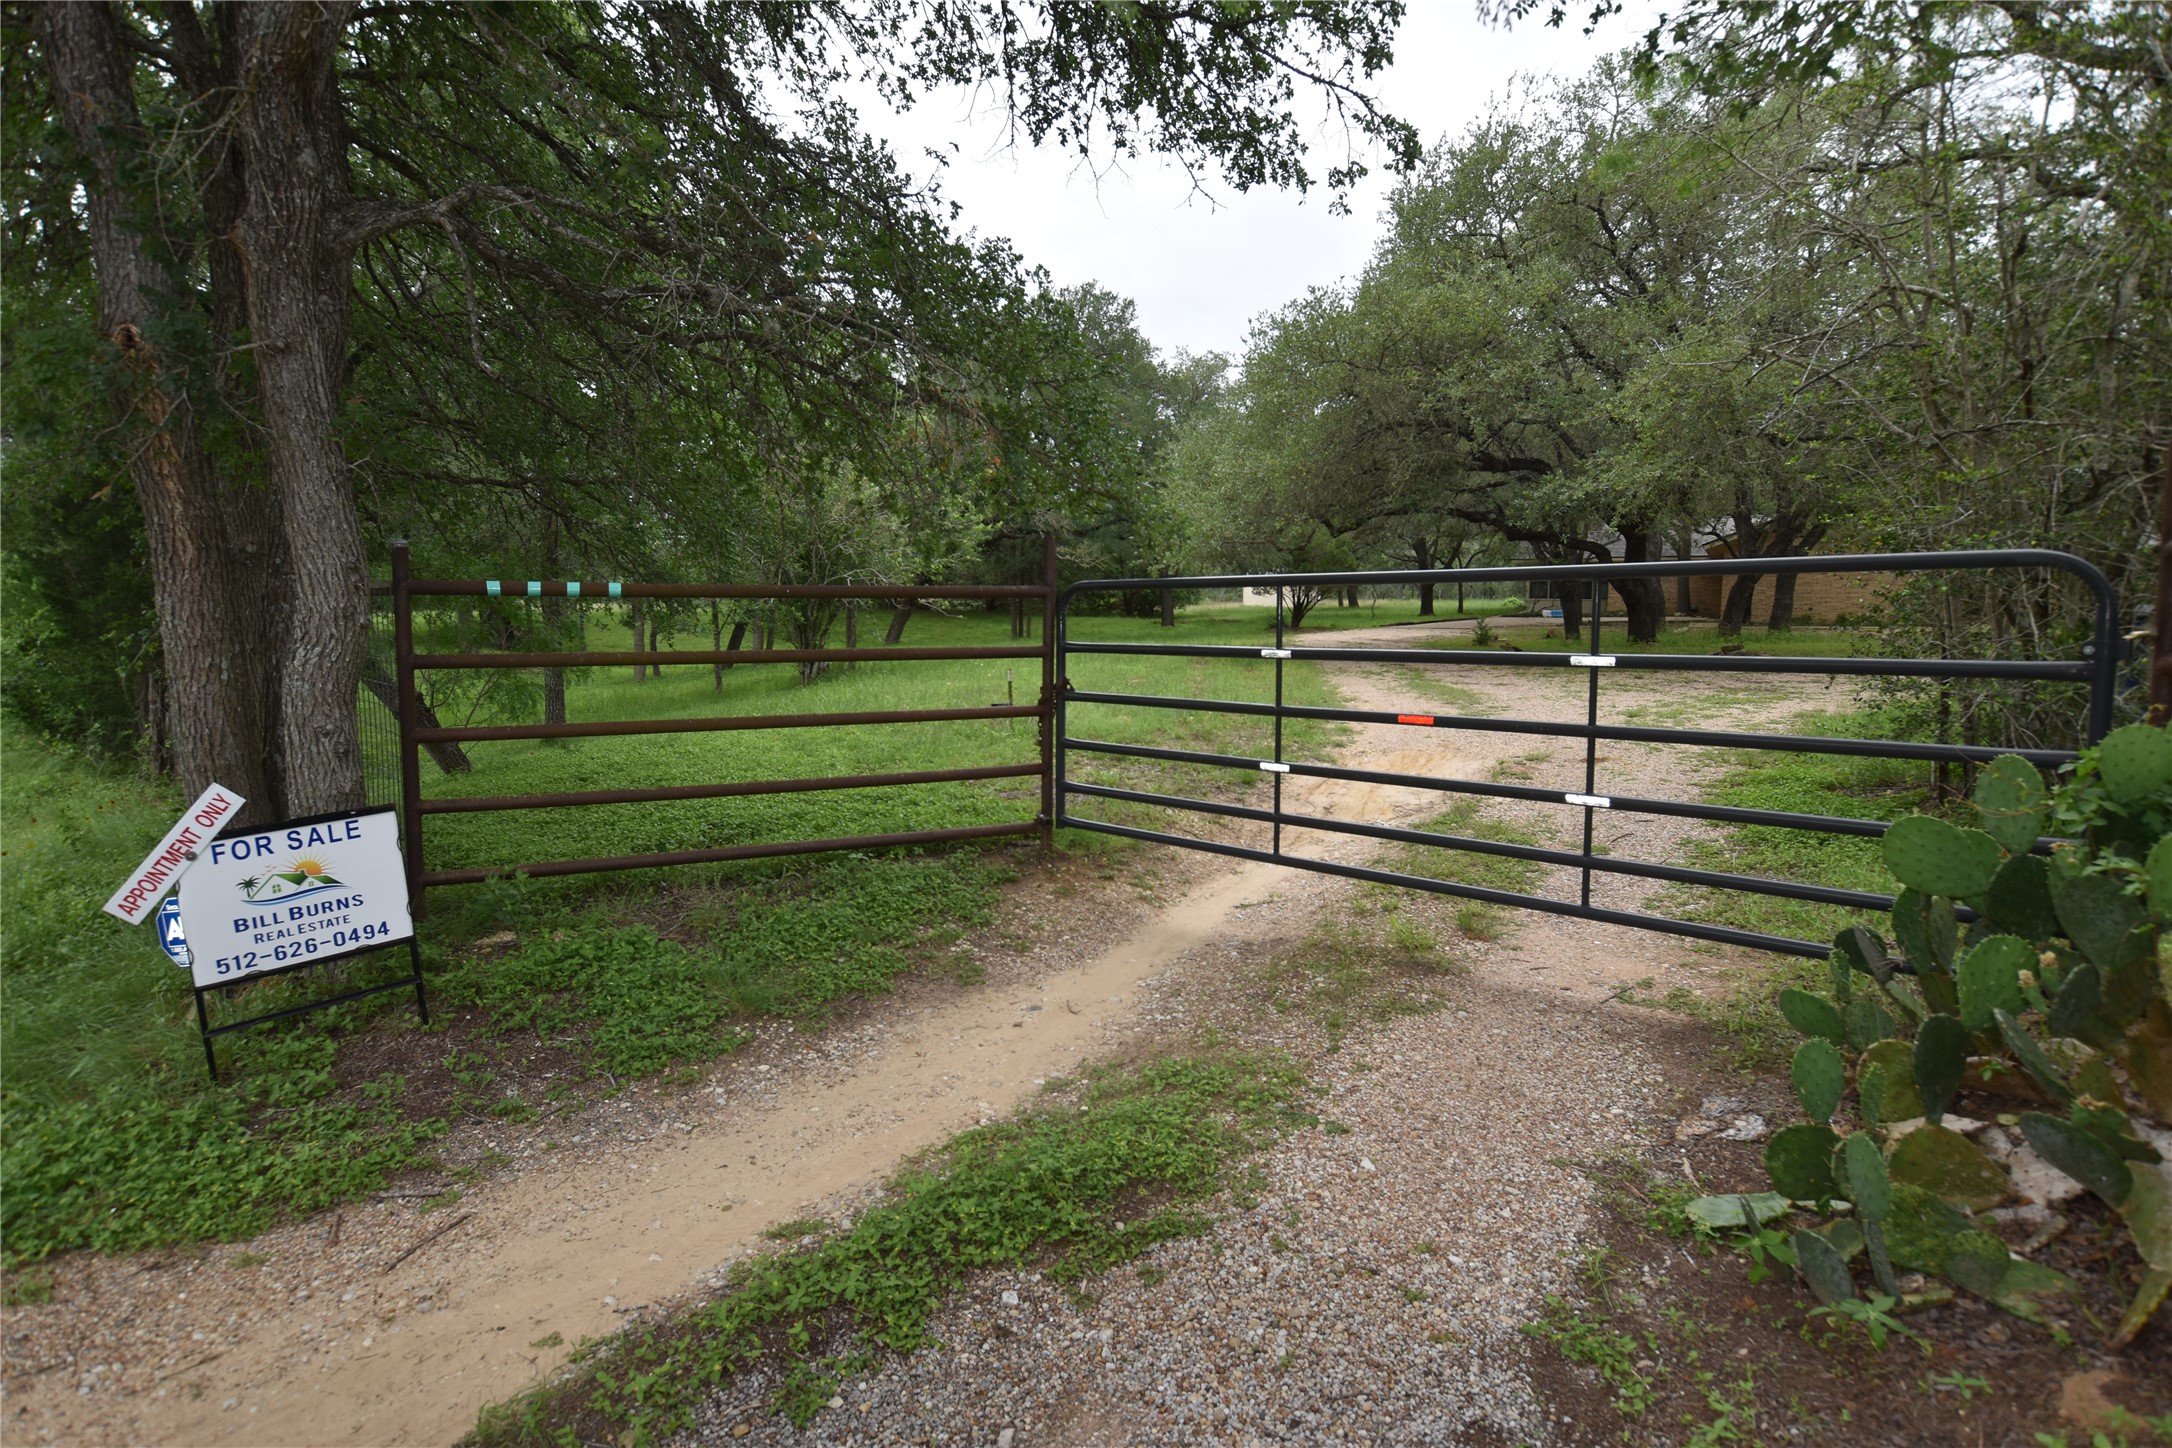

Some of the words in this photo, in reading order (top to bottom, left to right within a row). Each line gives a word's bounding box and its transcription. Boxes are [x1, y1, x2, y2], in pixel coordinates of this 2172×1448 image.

[117, 827, 202, 916] APPOINTMENT
[195, 793, 232, 828] ONLY
[211, 836, 275, 865] FOR
[286, 819, 362, 850] SALE
[233, 912, 284, 933] BILL
[289, 894, 364, 919] BURNS
[254, 924, 295, 944] REAL
[299, 914, 351, 934] ESTATE
[216, 920, 390, 974] 512-626-0494
